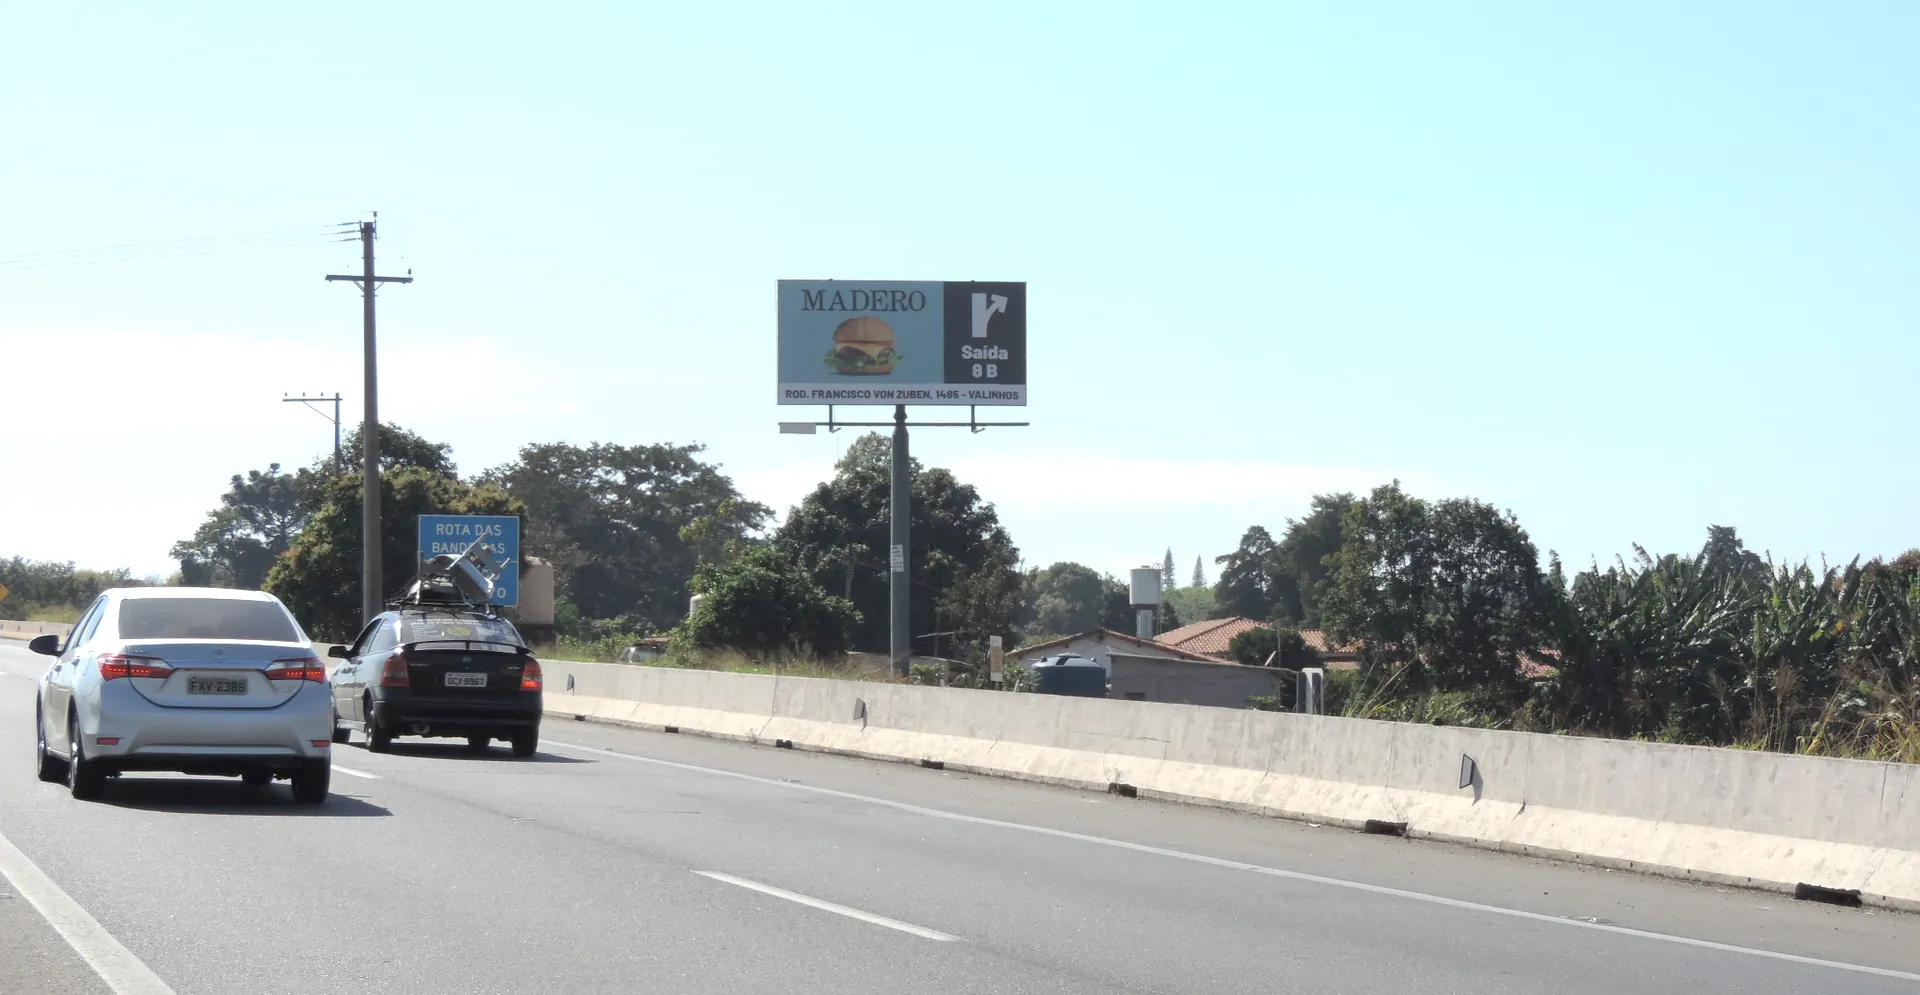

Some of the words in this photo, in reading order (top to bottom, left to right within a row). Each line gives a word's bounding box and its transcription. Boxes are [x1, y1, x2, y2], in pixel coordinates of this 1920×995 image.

[801, 289, 926, 312] MADERO
[961, 345, 1009, 360] Saída
[971, 363, 984, 379] 8
[986, 364, 999, 379] B
[785, 389, 809, 399] ROD.
[811, 389, 872, 399] FRANCISCO
[873, 390, 895, 400] VON
[896, 390, 933, 401] ZUBEN,
[936, 390, 960, 400] 1485
[968, 390, 1020, 401] VALINHOS
[436, 523, 471, 536] ROTA
[475, 524, 502, 537] DAS
